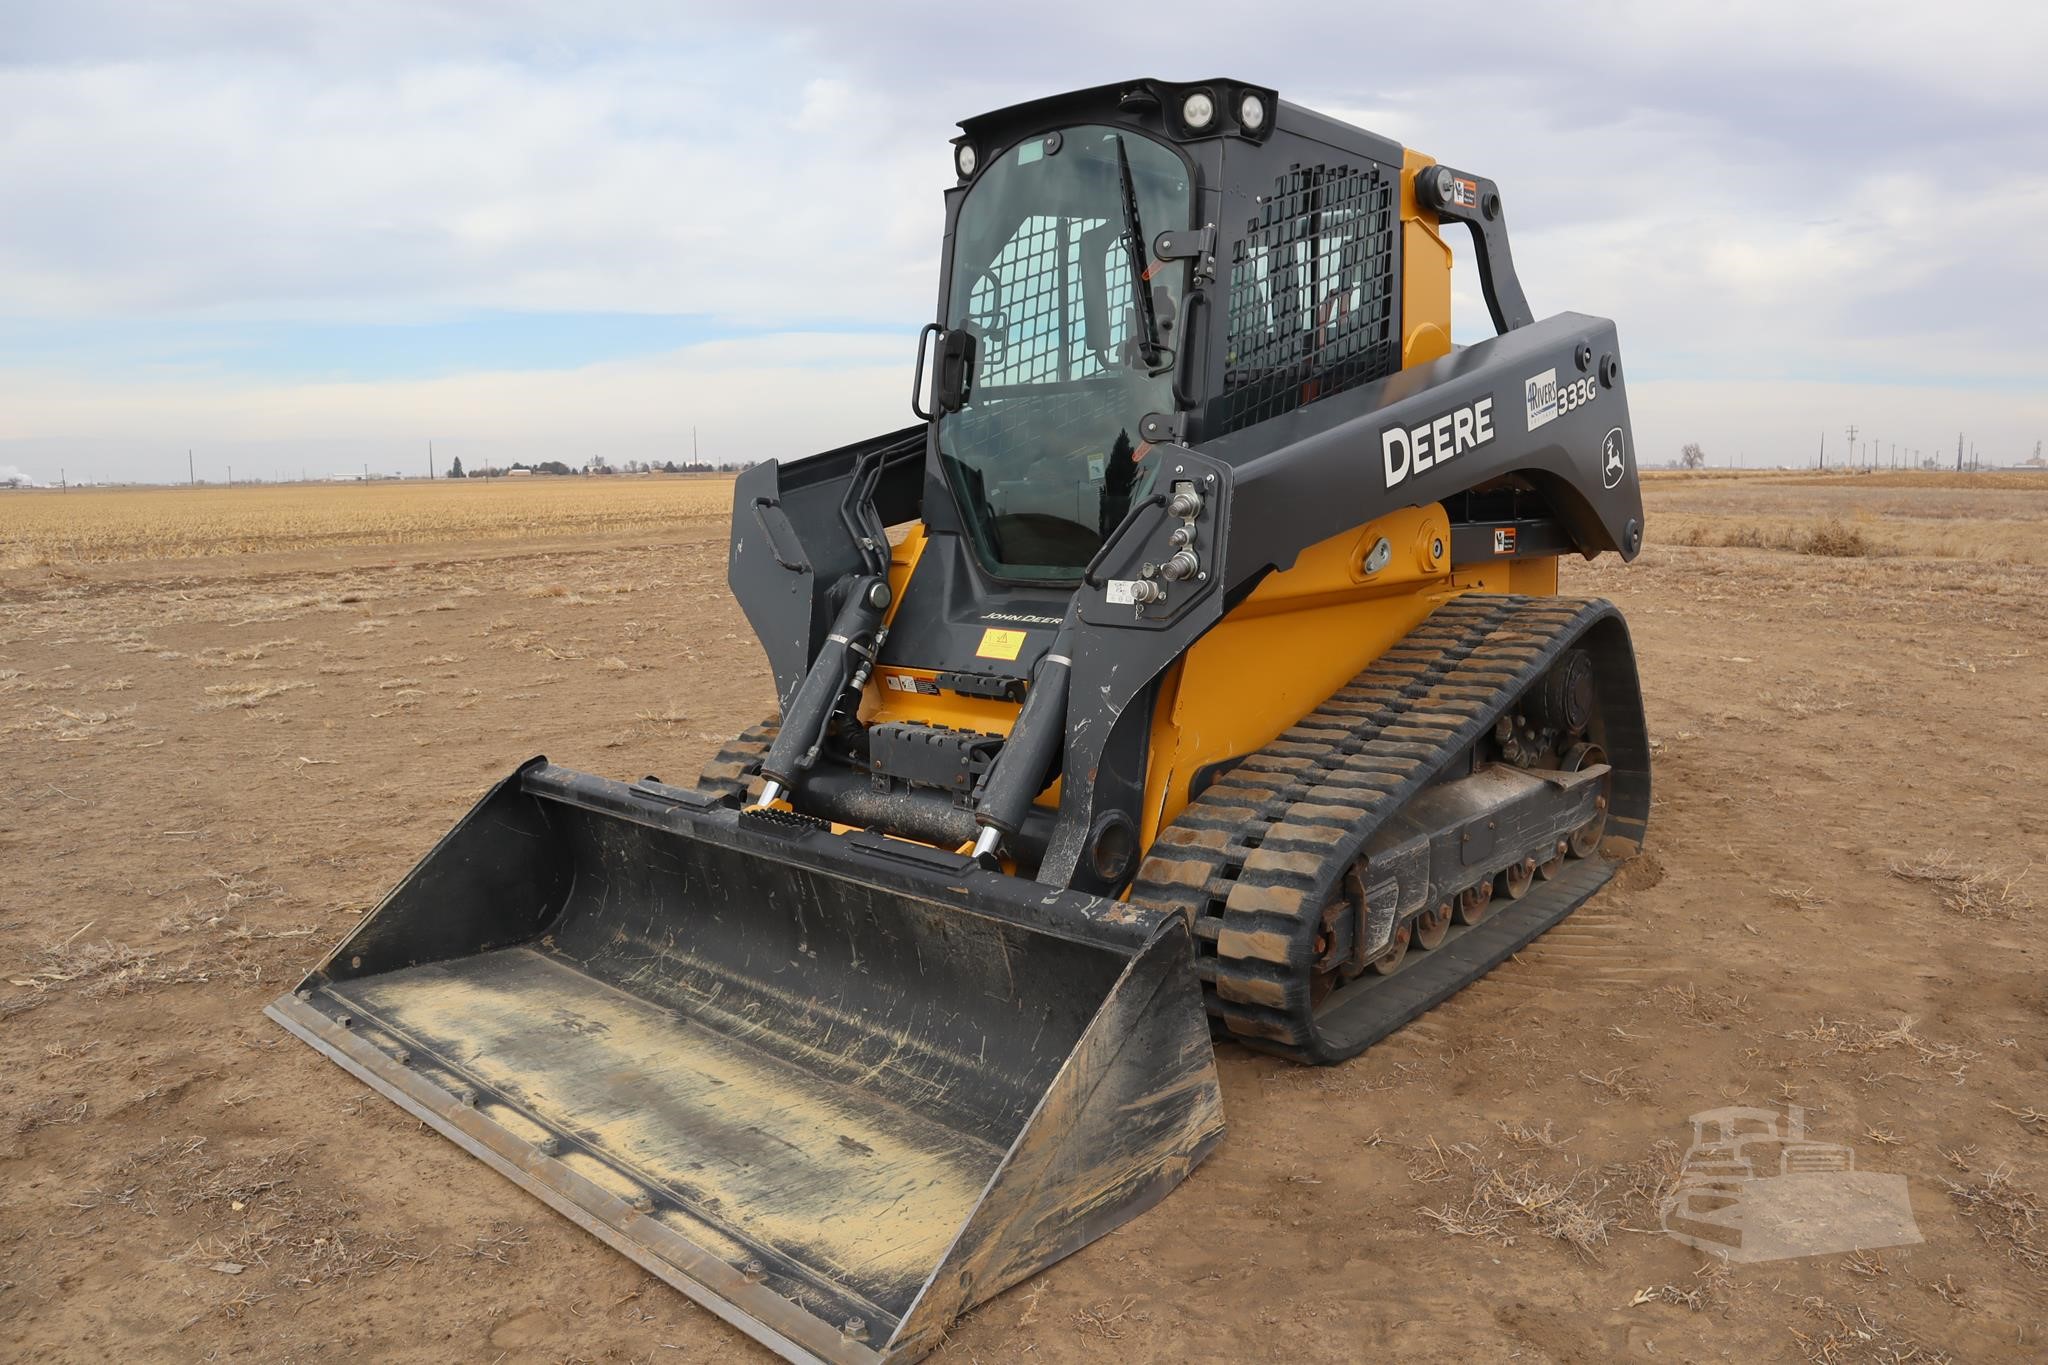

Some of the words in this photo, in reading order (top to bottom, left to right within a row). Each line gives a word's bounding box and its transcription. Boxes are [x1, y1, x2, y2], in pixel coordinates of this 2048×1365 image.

[1558, 376, 1596, 415] 333G
[1382, 397, 1495, 488] DEERE
[980, 612, 1020, 621] JOHN
[1021, 615, 1063, 624] DEER
